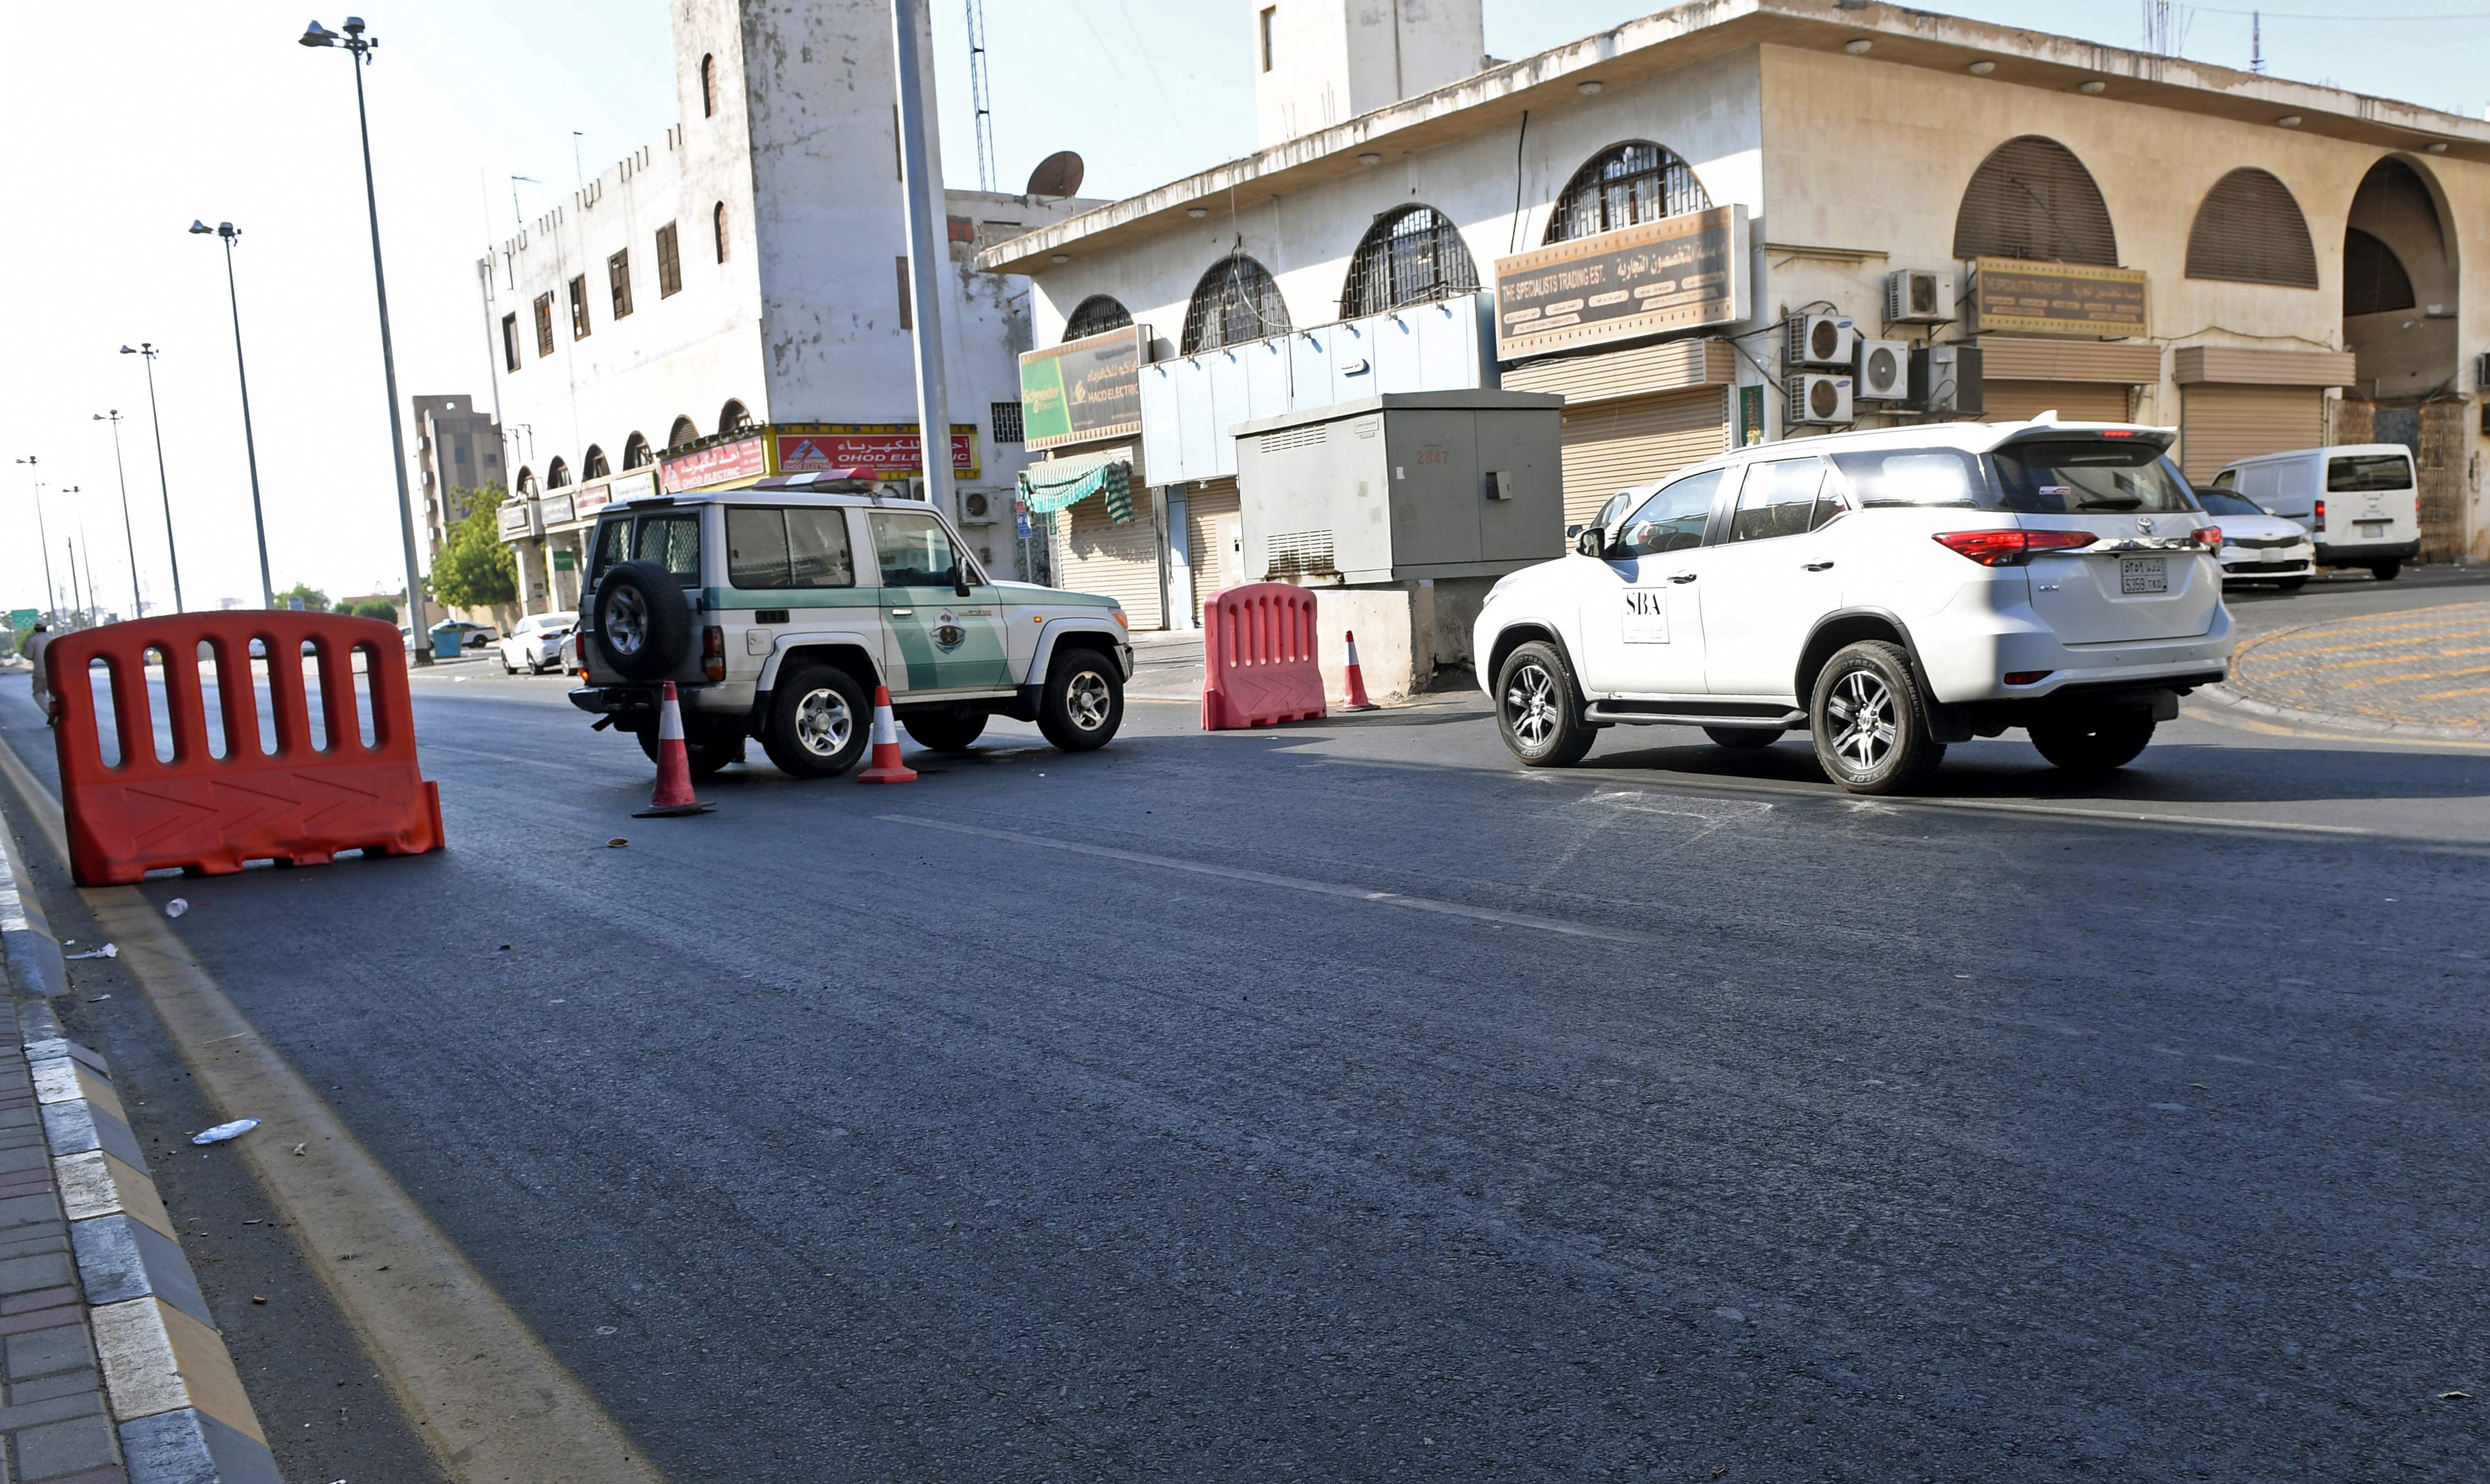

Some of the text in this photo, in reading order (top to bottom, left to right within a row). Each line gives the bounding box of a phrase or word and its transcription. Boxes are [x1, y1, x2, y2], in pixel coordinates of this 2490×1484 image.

[1502, 283, 1515, 302] THE
[1516, 274, 1558, 300] SPECIALISTS
[1558, 267, 1589, 291] TRADING
[890, 453, 968, 462] ELEIC
[1417, 451, 1449, 464] 2847
[682, 466, 741, 488] OHOD ELECTRIC
[1626, 592, 1661, 615] SBA
